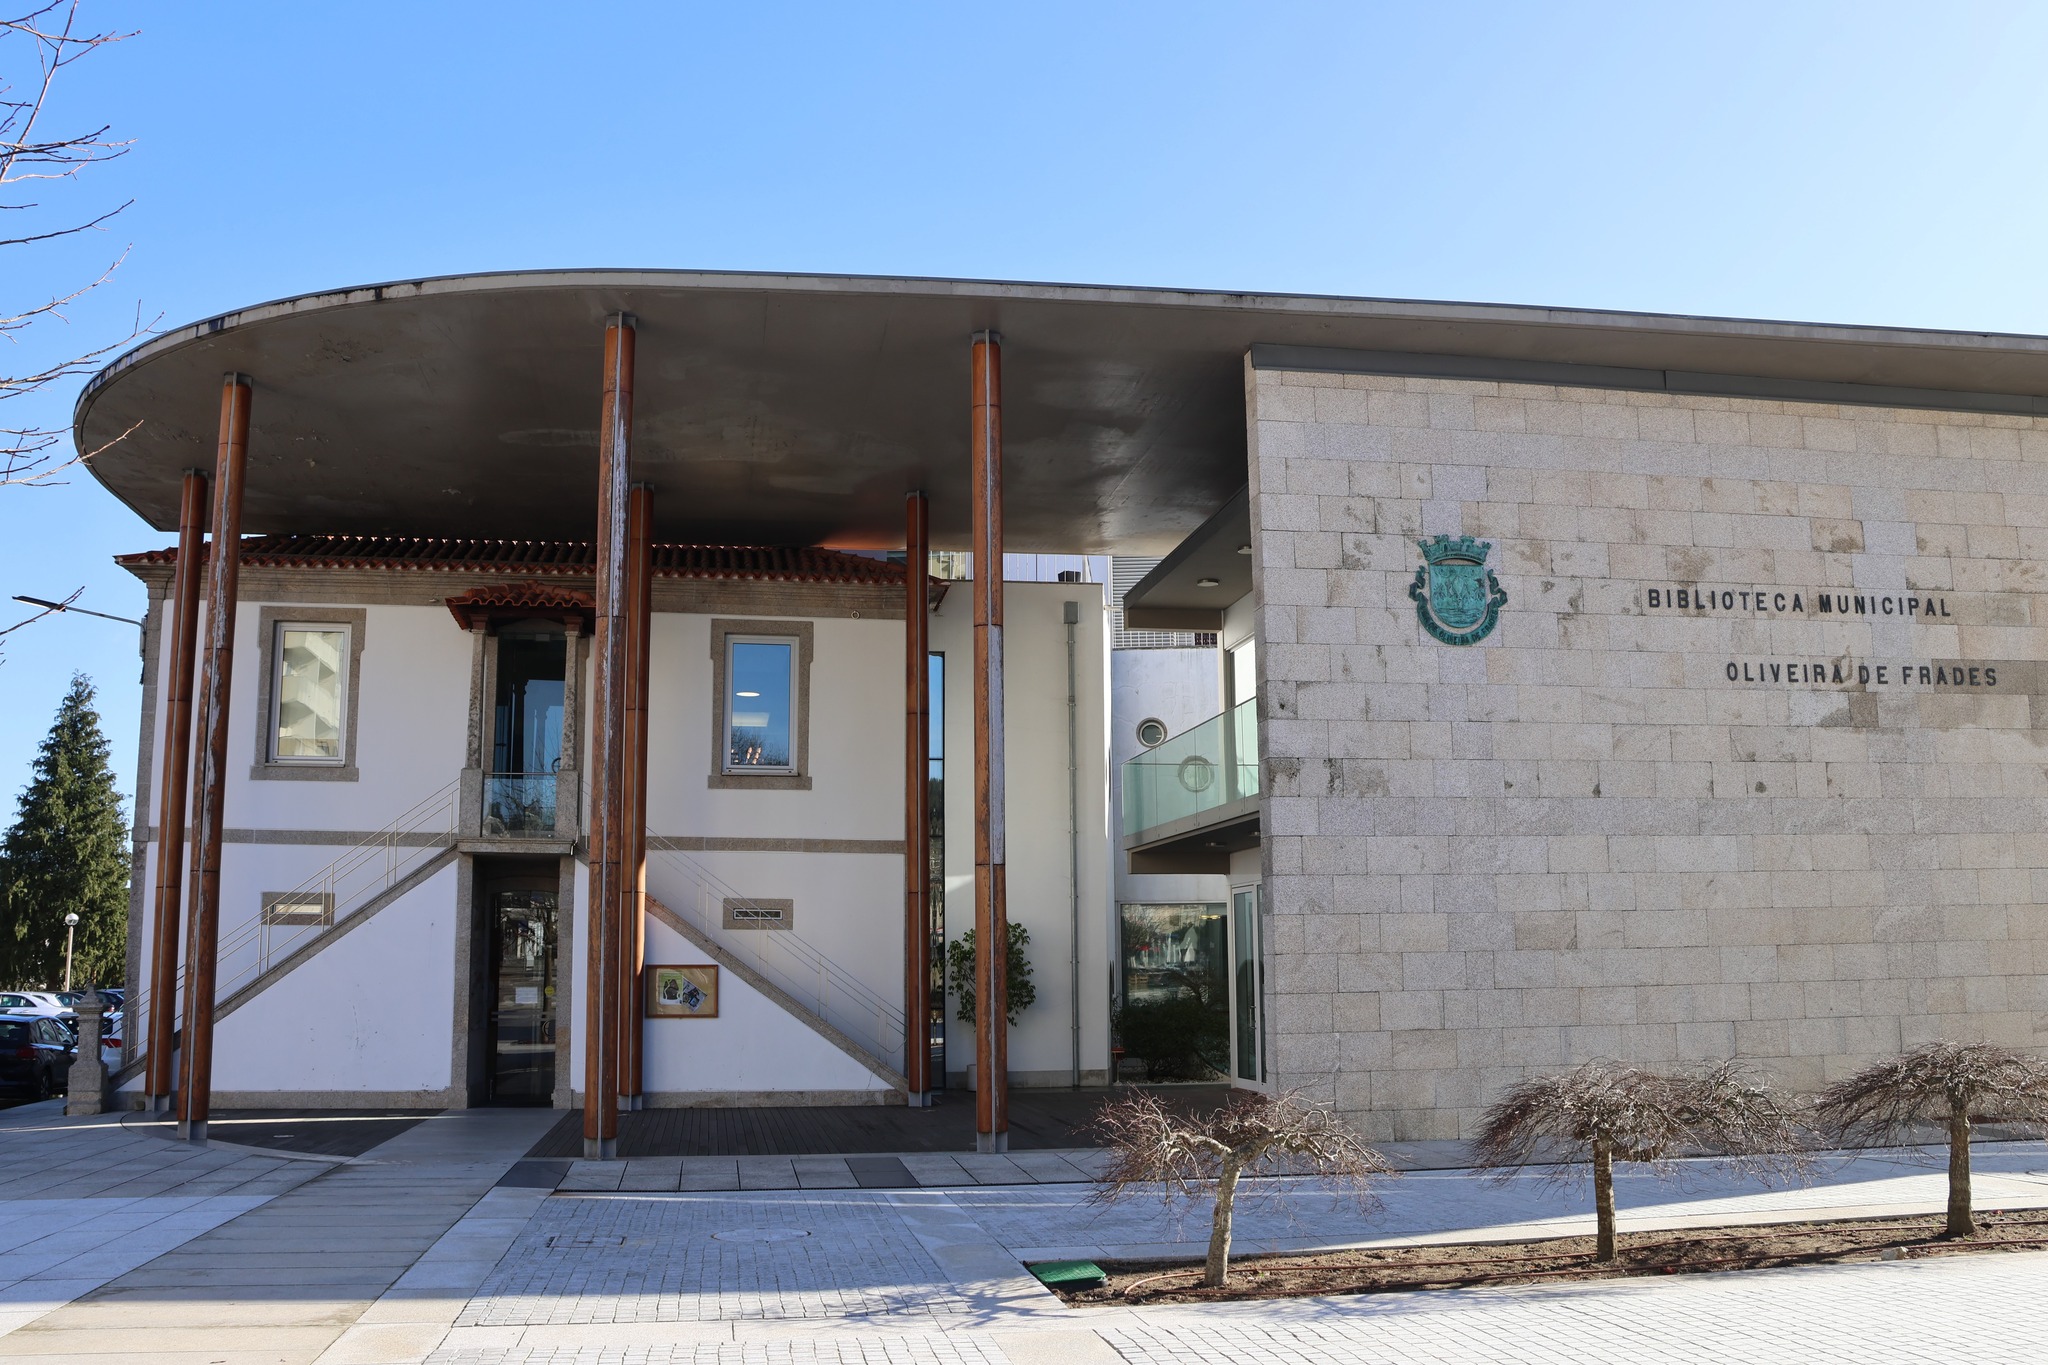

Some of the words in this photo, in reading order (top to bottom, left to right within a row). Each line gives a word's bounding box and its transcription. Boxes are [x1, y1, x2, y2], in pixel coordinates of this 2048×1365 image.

[1648, 588, 1804, 613] BIBLIOTECA
[1818, 594, 1951, 617] MUNICIPAL
[1726, 661, 1844, 683] OLIVEIRA
[1858, 665, 1888, 685] DE
[1902, 666, 1997, 687] FRADES
